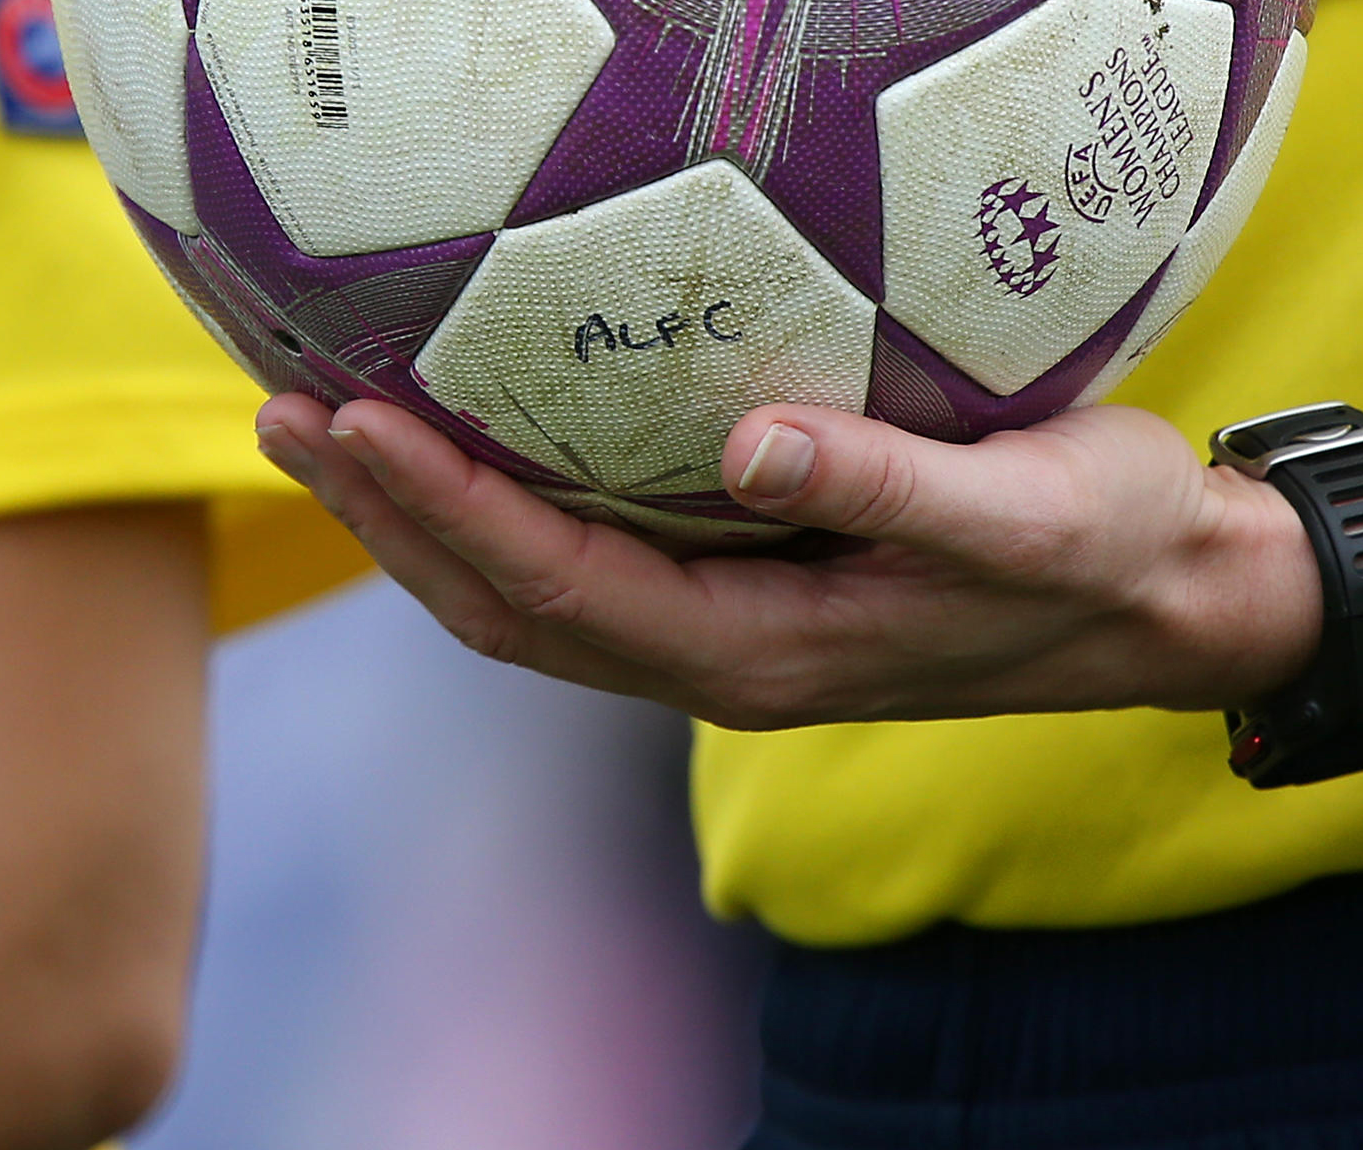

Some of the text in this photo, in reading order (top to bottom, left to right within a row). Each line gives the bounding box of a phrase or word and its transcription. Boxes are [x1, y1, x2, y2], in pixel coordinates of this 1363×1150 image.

[1071, 143, 1113, 216] UEFA
[1079, 70, 1157, 228] WOMEN'S
[1106, 47, 1181, 200] CHAMPIONS
[574, 300, 743, 363] ALFC
